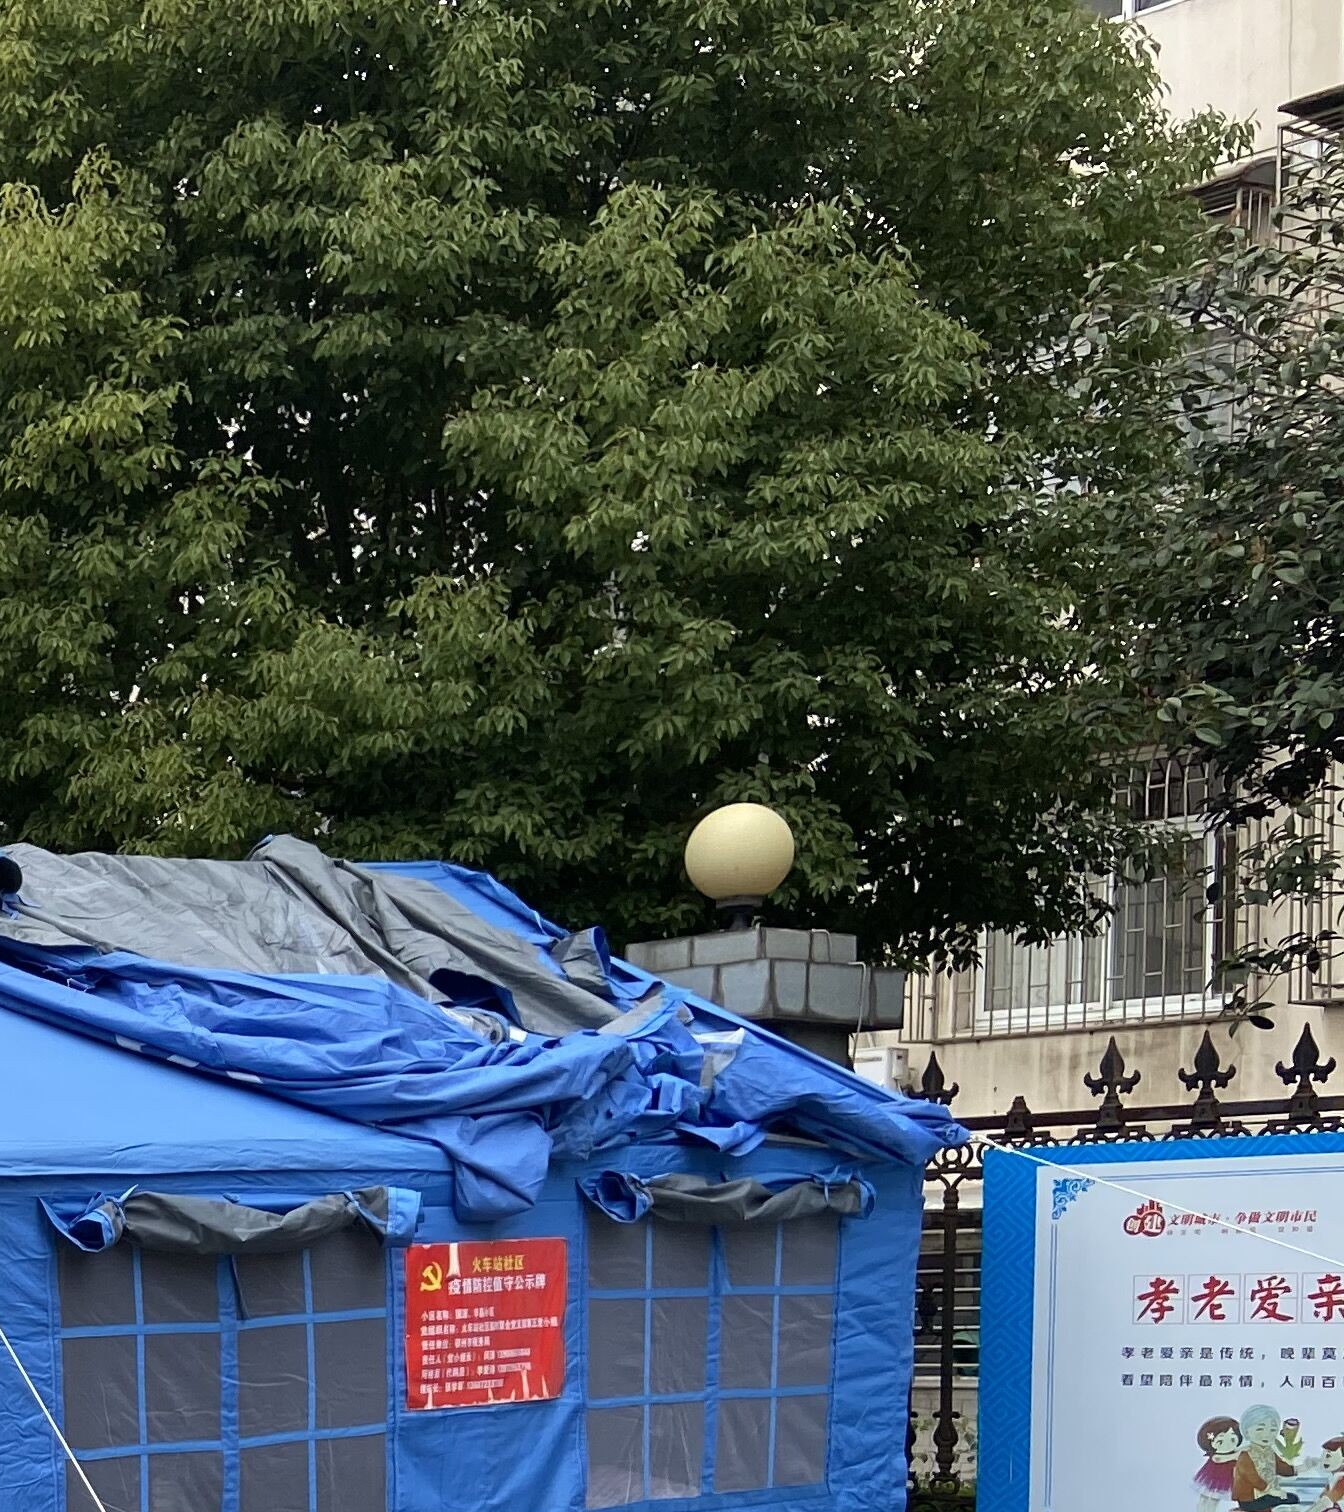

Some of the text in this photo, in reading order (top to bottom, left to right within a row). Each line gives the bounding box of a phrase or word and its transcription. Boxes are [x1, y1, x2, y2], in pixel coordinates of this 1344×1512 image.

[448, 1273, 547, 1295] 疫情防控值守公示牌
[1137, 1273, 1344, 1324] 孝老爱亲
[1121, 1346, 1344, 1361] 孝老爱亲是传统，晚辈莫
[1121, 1373, 1344, 1388] 看望陪伴最常情，人间百
